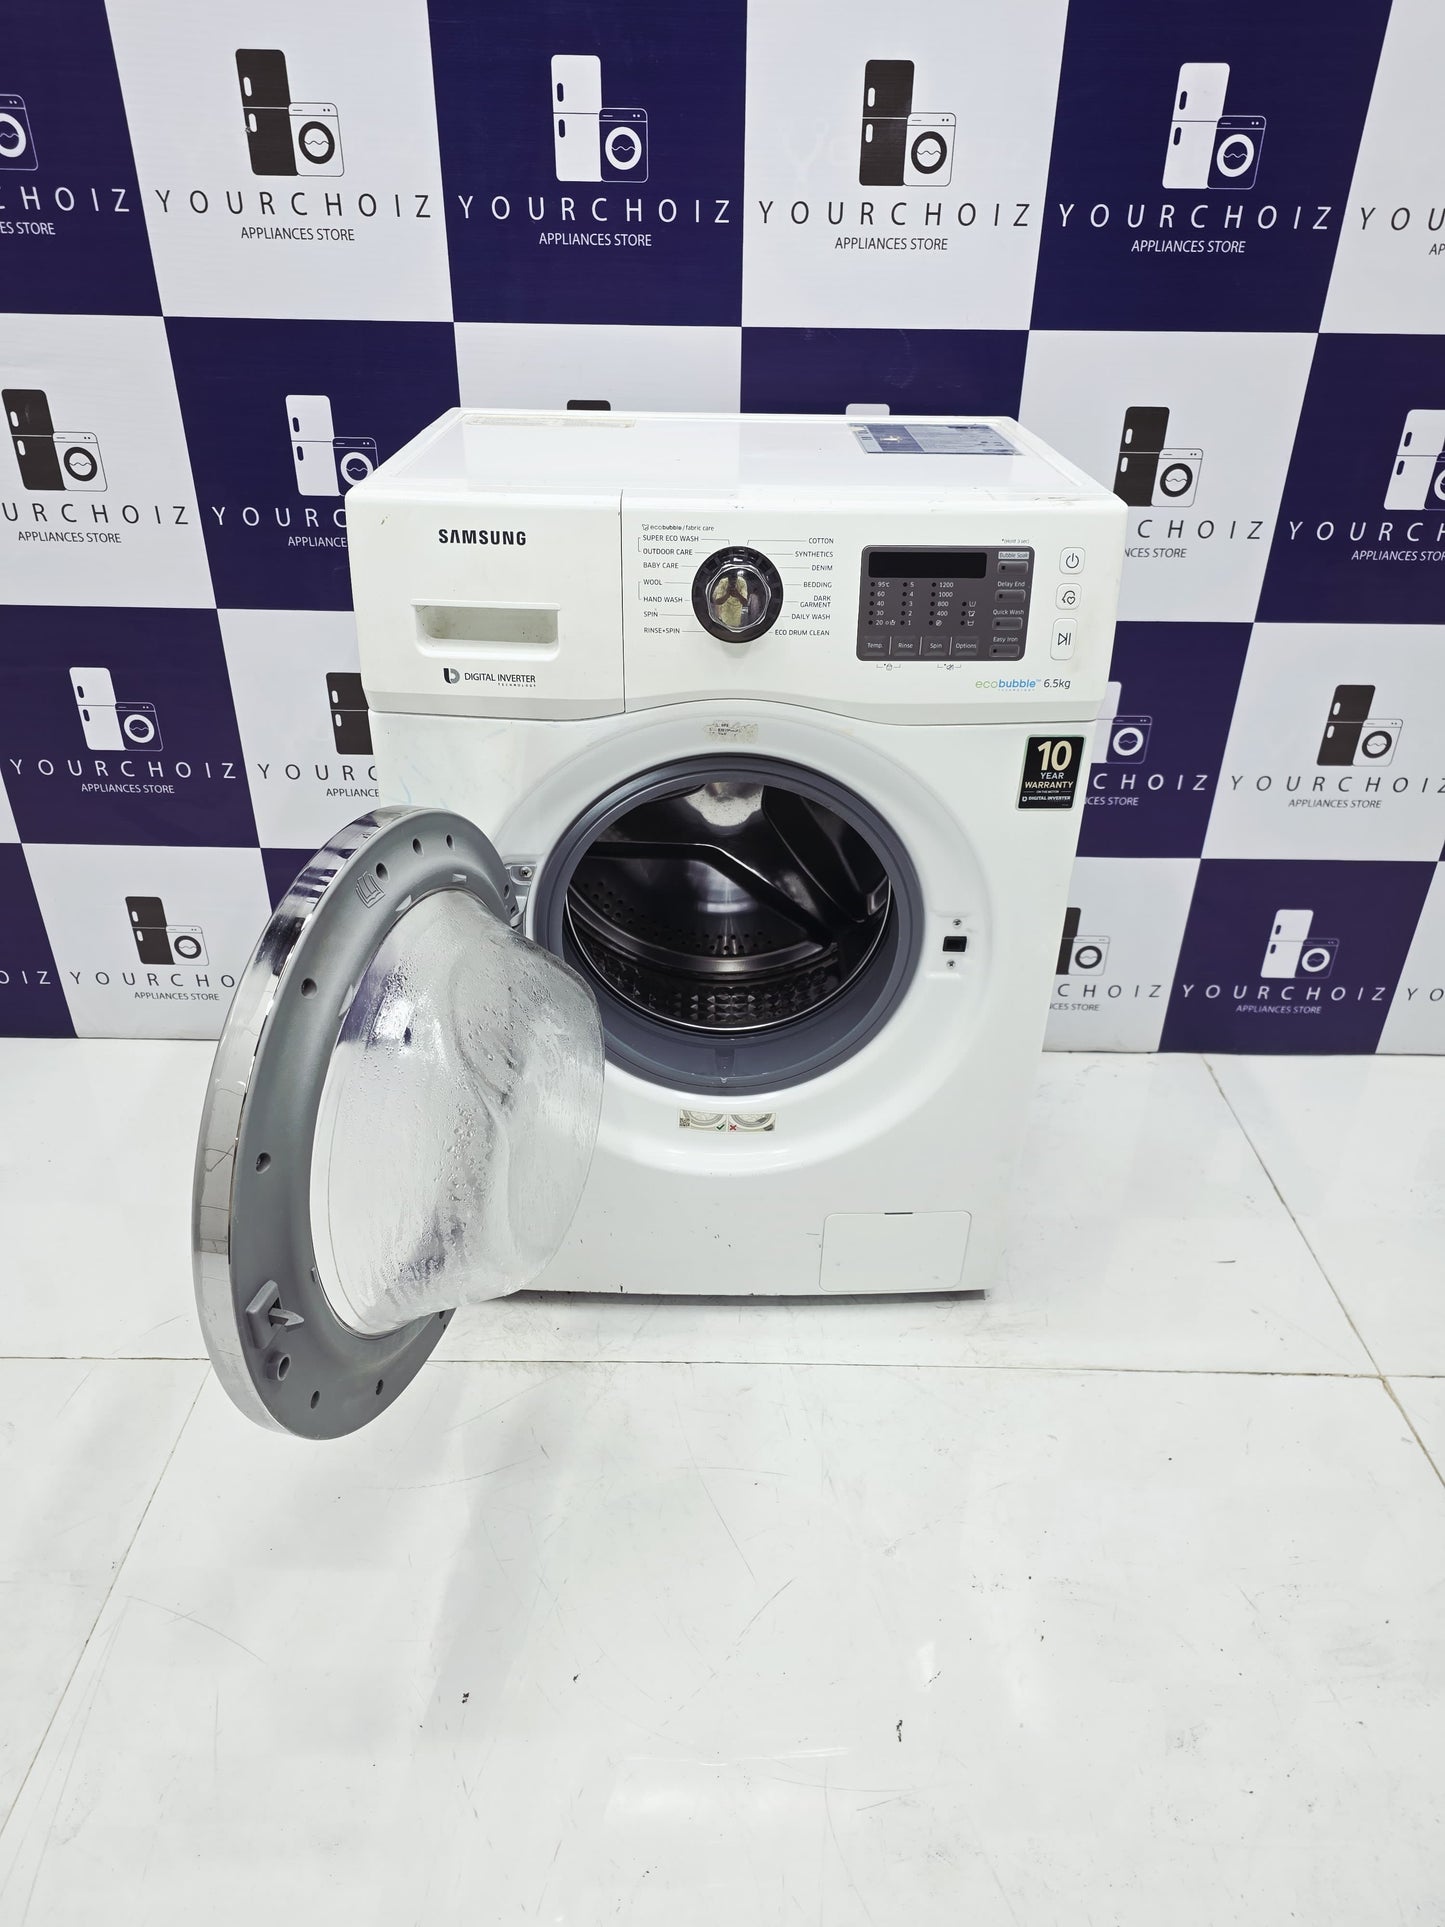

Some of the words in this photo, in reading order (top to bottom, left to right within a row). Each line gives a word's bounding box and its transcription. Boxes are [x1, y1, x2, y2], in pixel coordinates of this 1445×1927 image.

[155, 190, 430, 217] YOURCHOIZ
[458, 196, 729, 223] YOURCHOIZ
[759, 201, 1029, 226] YOURCHOIZ
[1060, 204, 1331, 229] YOURCHOIZ
[16, 222, 55, 235] STORE
[241, 227, 313, 240] APPLIANCES
[317, 229, 354, 240] STORE
[539, 233, 611, 245] APPLIANCES
[615, 234, 651, 246] STORE
[835, 237, 906, 249] APPLIANCES
[910, 238, 948, 250] STORE
[1131, 240, 1204, 252] APPLIANCES
[1207, 241, 1246, 253] STORE
[19, 532, 84, 542] APPLIANCES
[86, 533, 121, 543] STORE
[439, 529, 526, 545] SAMSUNG
[1153, 548, 1187, 558] STORE
[1352, 551, 1418, 560] APPLIANCES
[464, 672, 496, 681] DIGITAL
[498, 674, 536, 682] INVERTER
[1044, 679, 1071, 689] 6.5kg
[1038, 740, 1073, 771] 10
[10, 759, 236, 778] YOURCHOIZ
[82, 784, 141, 793] APPLIANCES
[143, 785, 174, 793] STORE
[1108, 797, 1139, 805] STORE
[1351, 800, 1381, 808] STORE
[135, 992, 188, 1000] APPLIANCES
[1183, 985, 1385, 1000] YOURCHOIZ
[1237, 1005, 1291, 1013] APPLIANCES
